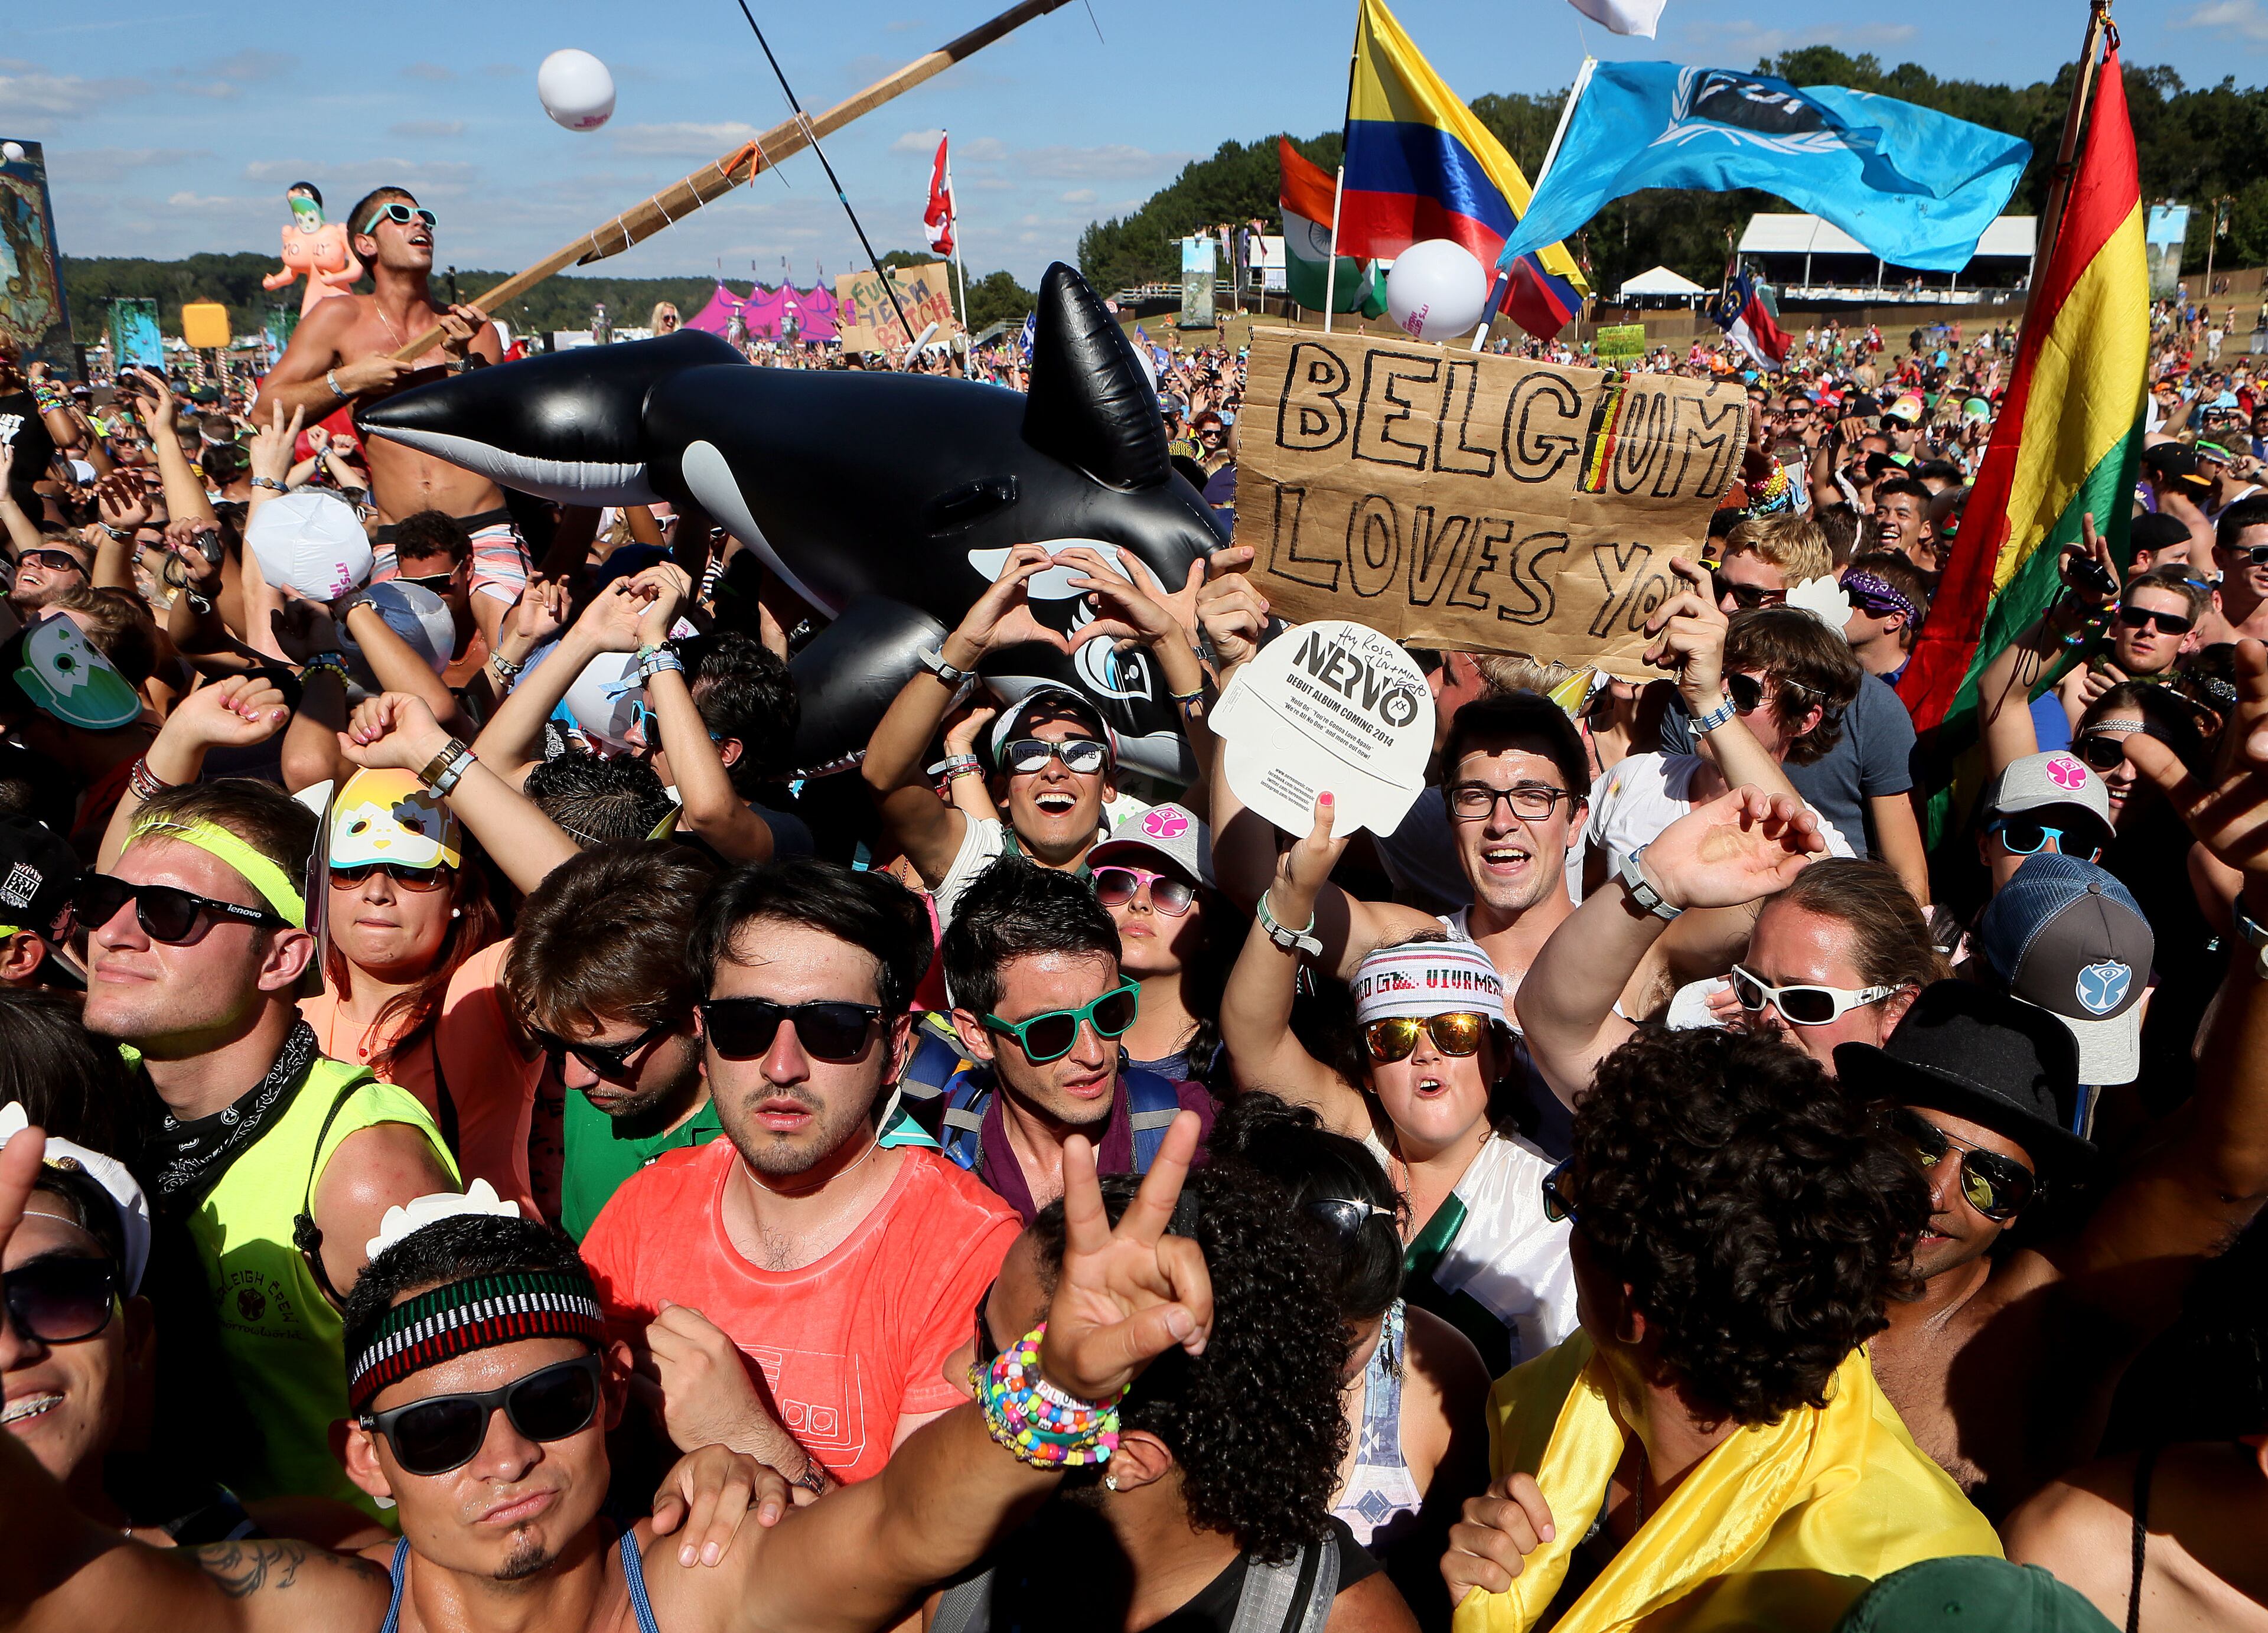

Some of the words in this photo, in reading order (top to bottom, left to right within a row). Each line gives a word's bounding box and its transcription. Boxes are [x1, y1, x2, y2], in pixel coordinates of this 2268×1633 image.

[850, 271, 908, 308] FUCK
[858, 278, 931, 329] YEAH
[874, 291, 950, 350] BITCH
[1275, 341, 1747, 498] BELGIUM
[1267, 484, 1570, 626] LOVES
[1292, 629, 1418, 728] NERVO
[1286, 673, 1314, 695] DEBUT
[1311, 689, 1342, 713] ALBUM
[1340, 707, 1374, 734] COMING
[1371, 728, 1394, 748] 2014
[1306, 715, 1314, 724] No
[1325, 728, 1336, 738] and
[1335, 734, 1349, 747] more
[1348, 742, 1358, 752] out
[1357, 748, 1371, 761] now!
[1328, 720, 1345, 735] Gonna
[1345, 729, 1357, 742] Love
[227, 904, 262, 918] lenovo
